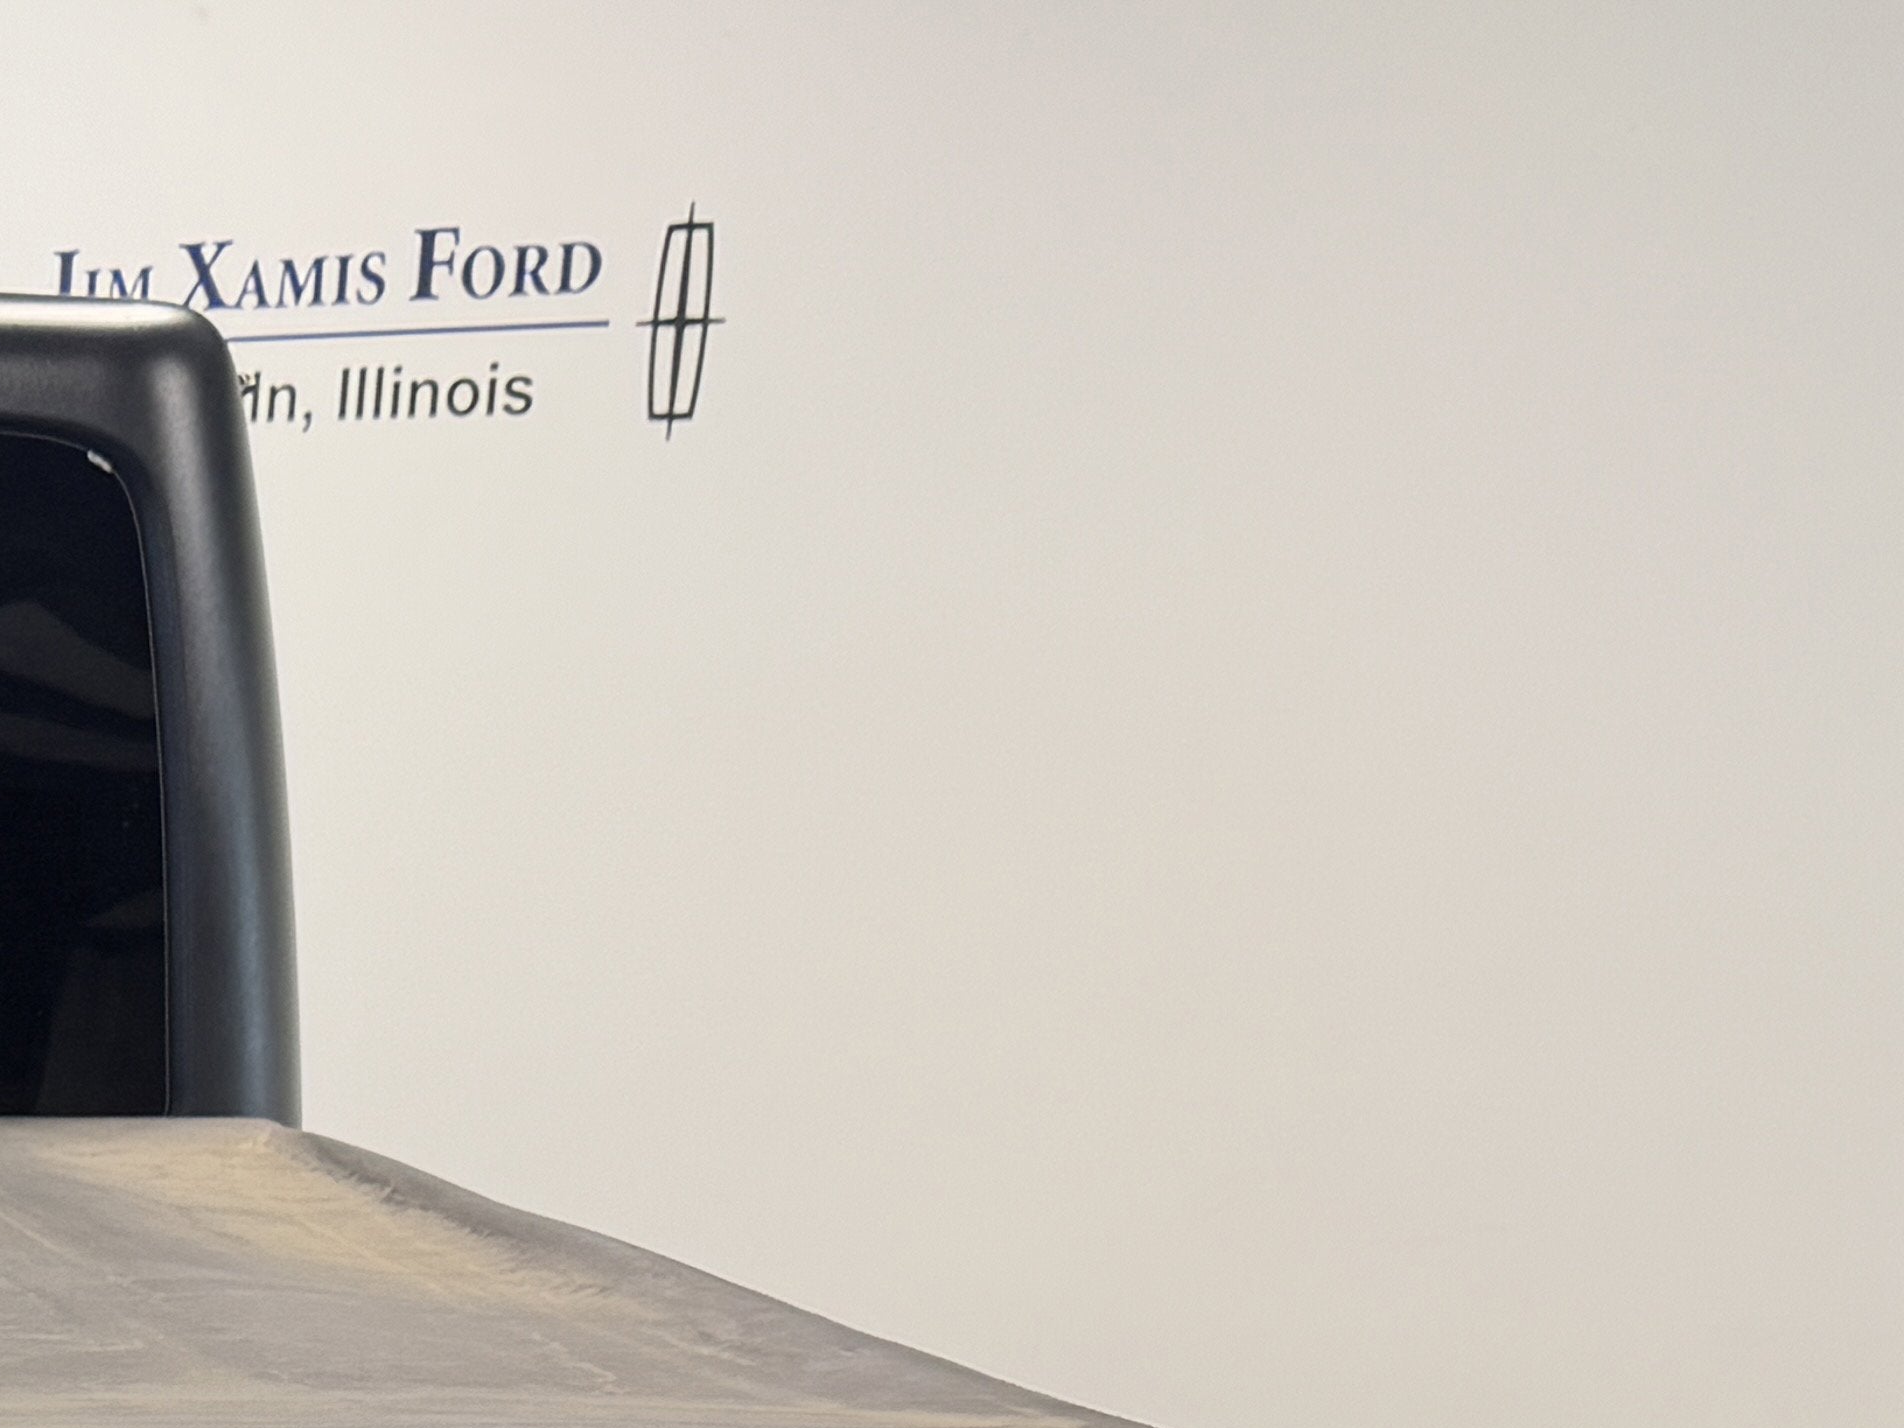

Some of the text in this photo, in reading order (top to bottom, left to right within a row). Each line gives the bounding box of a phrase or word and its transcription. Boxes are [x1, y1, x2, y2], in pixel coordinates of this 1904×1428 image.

[179, 240, 388, 312] XAMIS
[410, 227, 603, 303] FORD
[337, 362, 534, 421] Illinois
